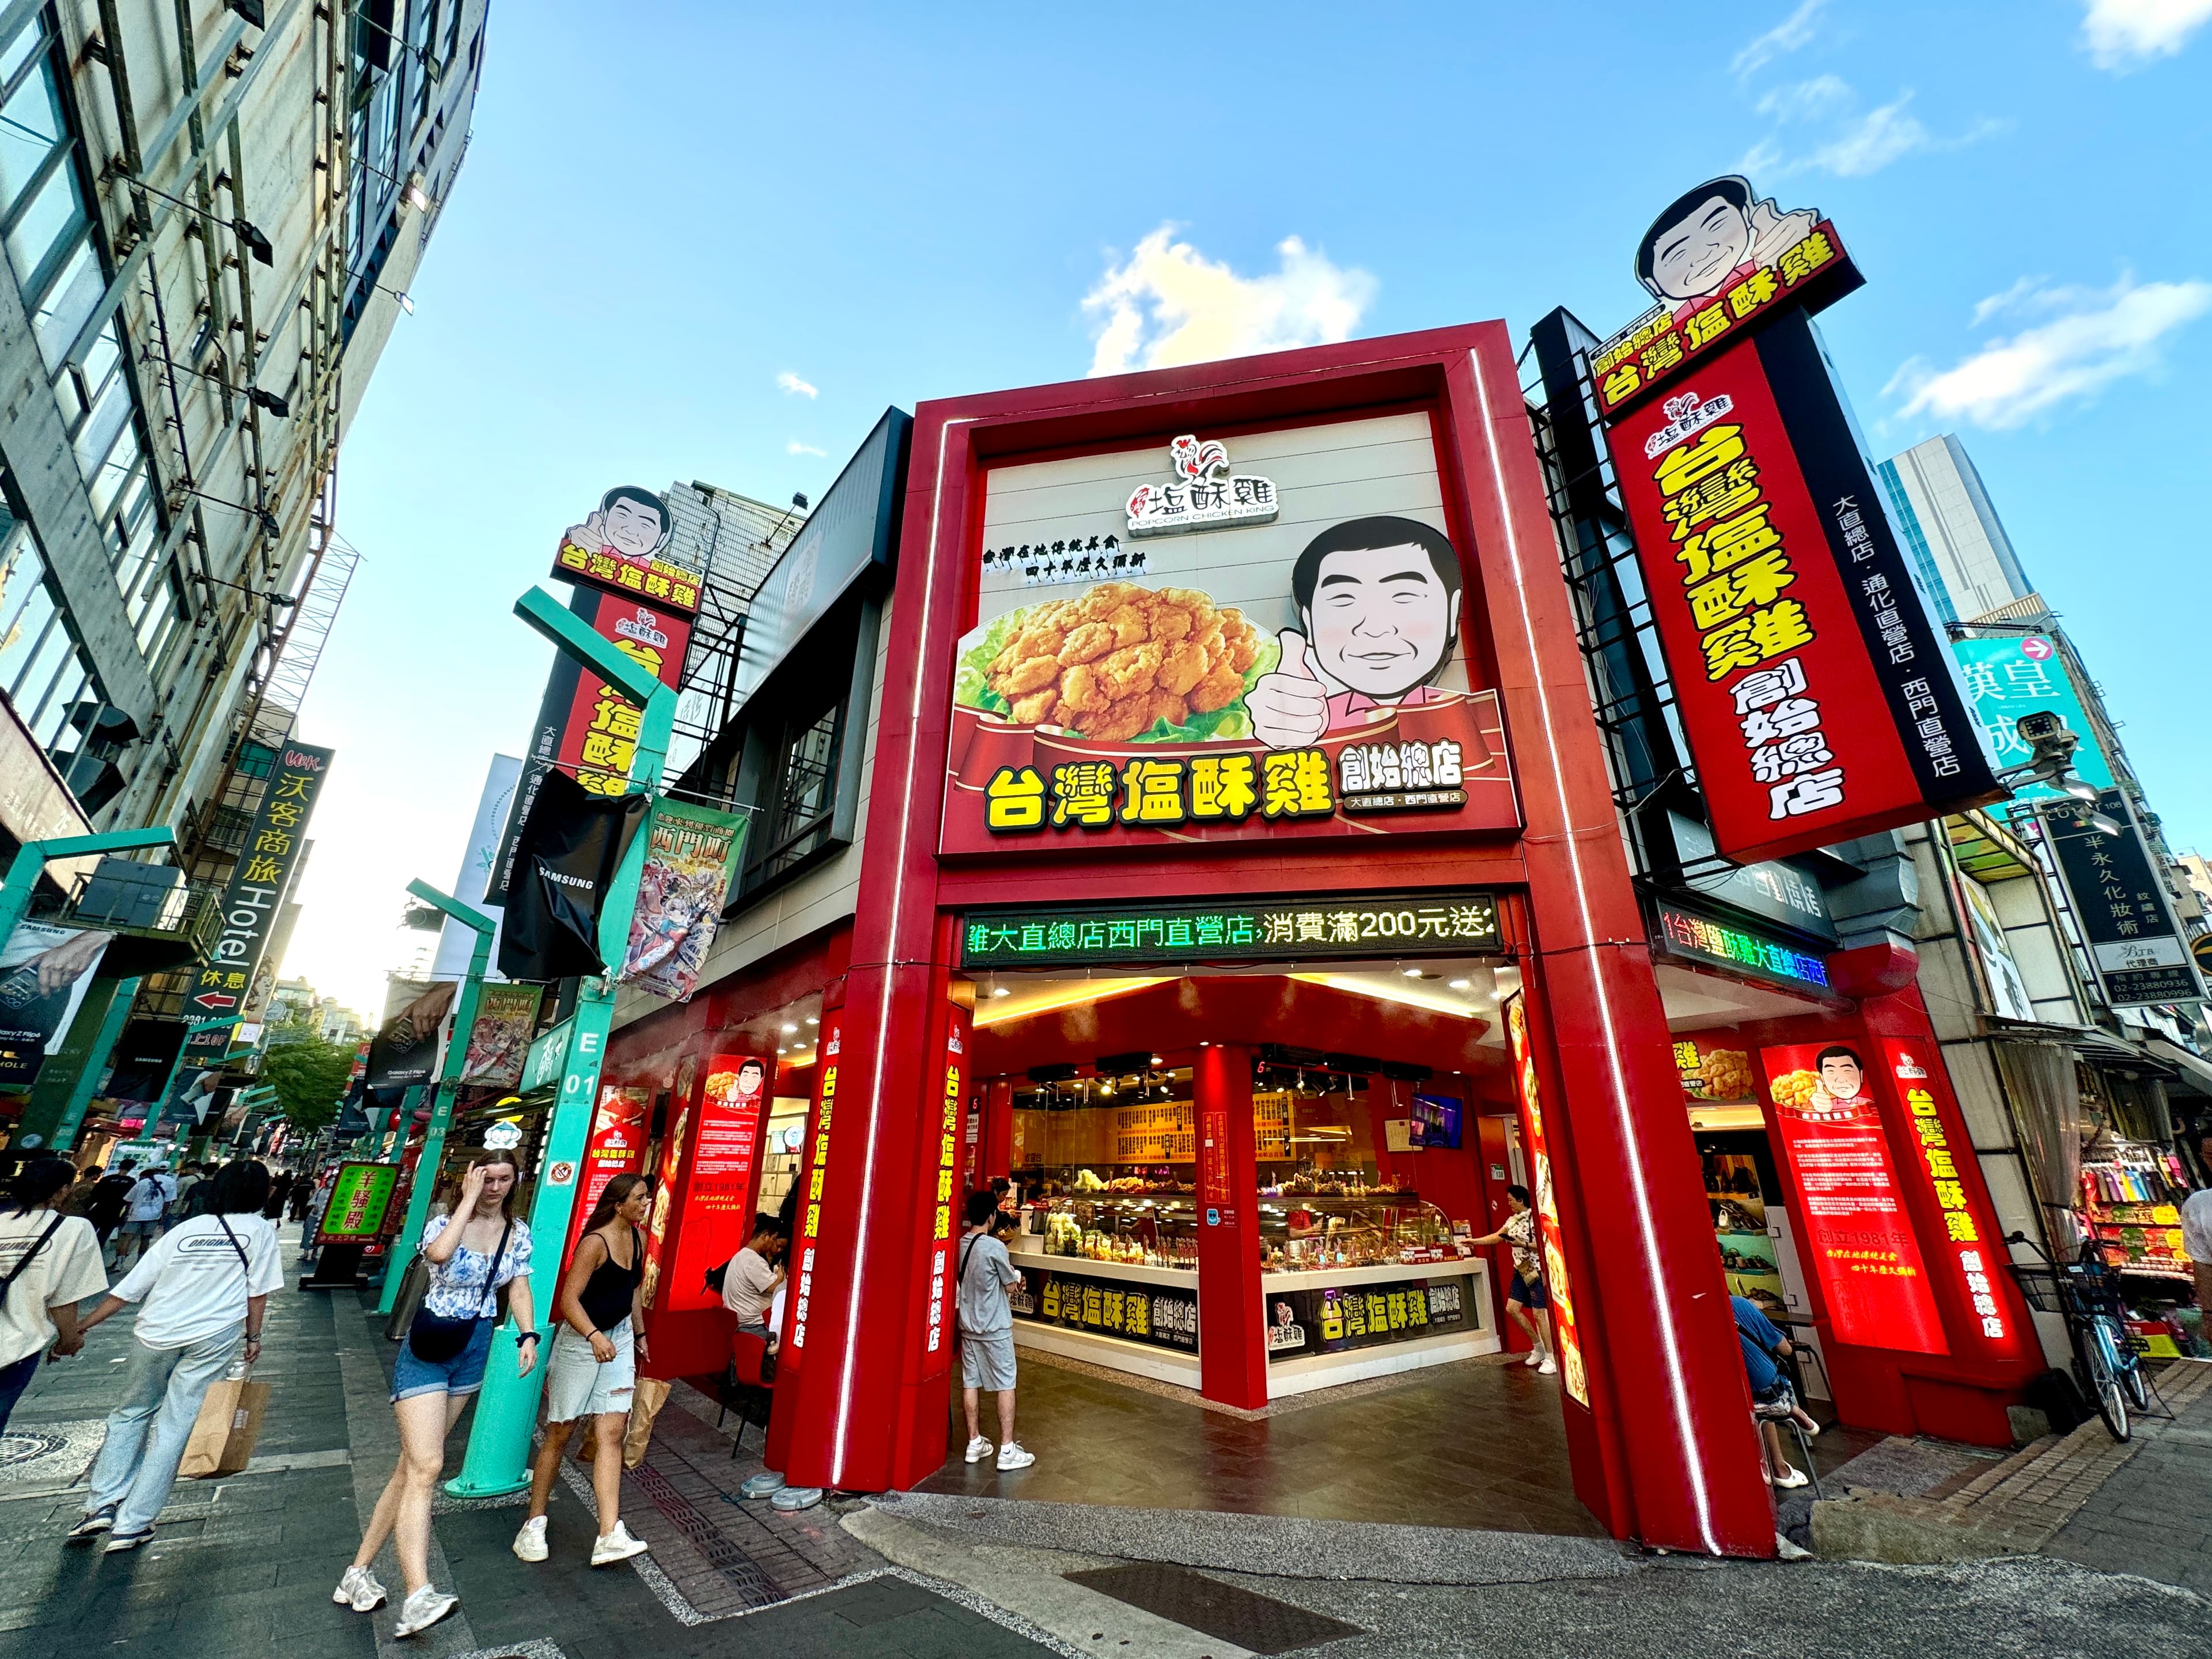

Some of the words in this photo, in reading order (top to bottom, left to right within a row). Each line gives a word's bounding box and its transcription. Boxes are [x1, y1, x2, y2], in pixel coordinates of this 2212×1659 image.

[1603, 232, 1834, 405] 台灣塩酥雞
[1132, 516, 1188, 527] POPCORN
[1192, 509, 1242, 520] CHICKEN
[1149, 479, 1273, 515] 塩酥雞
[561, 544, 697, 609] 台灣塩酥雞
[1654, 424, 1813, 680] 台灣塩酥雞
[1730, 658, 1843, 819] 創始總店
[987, 751, 1331, 828] 台灣塩酥雞
[1340, 741, 1461, 792] 創始總店
[243, 772, 314, 885] 沃客商旅
[2104, 801, 2122, 809] 108
[650, 824, 732, 863] 西門町
[539, 866, 594, 890] SAMSUNG
[2084, 835, 2139, 935] 半永久化妝術
[20, 924, 66, 934] SAMSUNG
[217, 886, 279, 967] Hotel
[200, 969, 246, 990] 休息
[579, 1033, 599, 1052] E
[565, 1075, 595, 1094] 01
[430, 1127, 445, 1137] 03
[438, 1106, 448, 1116] E
[934, 1065, 960, 1240] 台灣塩酥雞
[1907, 1088, 1979, 1243] 台灣塩酥雞
[188, 1238, 238, 1247] ORIGINA
[928, 1249, 945, 1353] 創始總店
[1043, 1280, 1149, 1335] 台灣塩酥雞
[1153, 1298, 1196, 1334] 創始總店
[1323, 1290, 1428, 1340] 台灣塩酥雞
[1959, 1249, 2003, 1338] 創始總店
